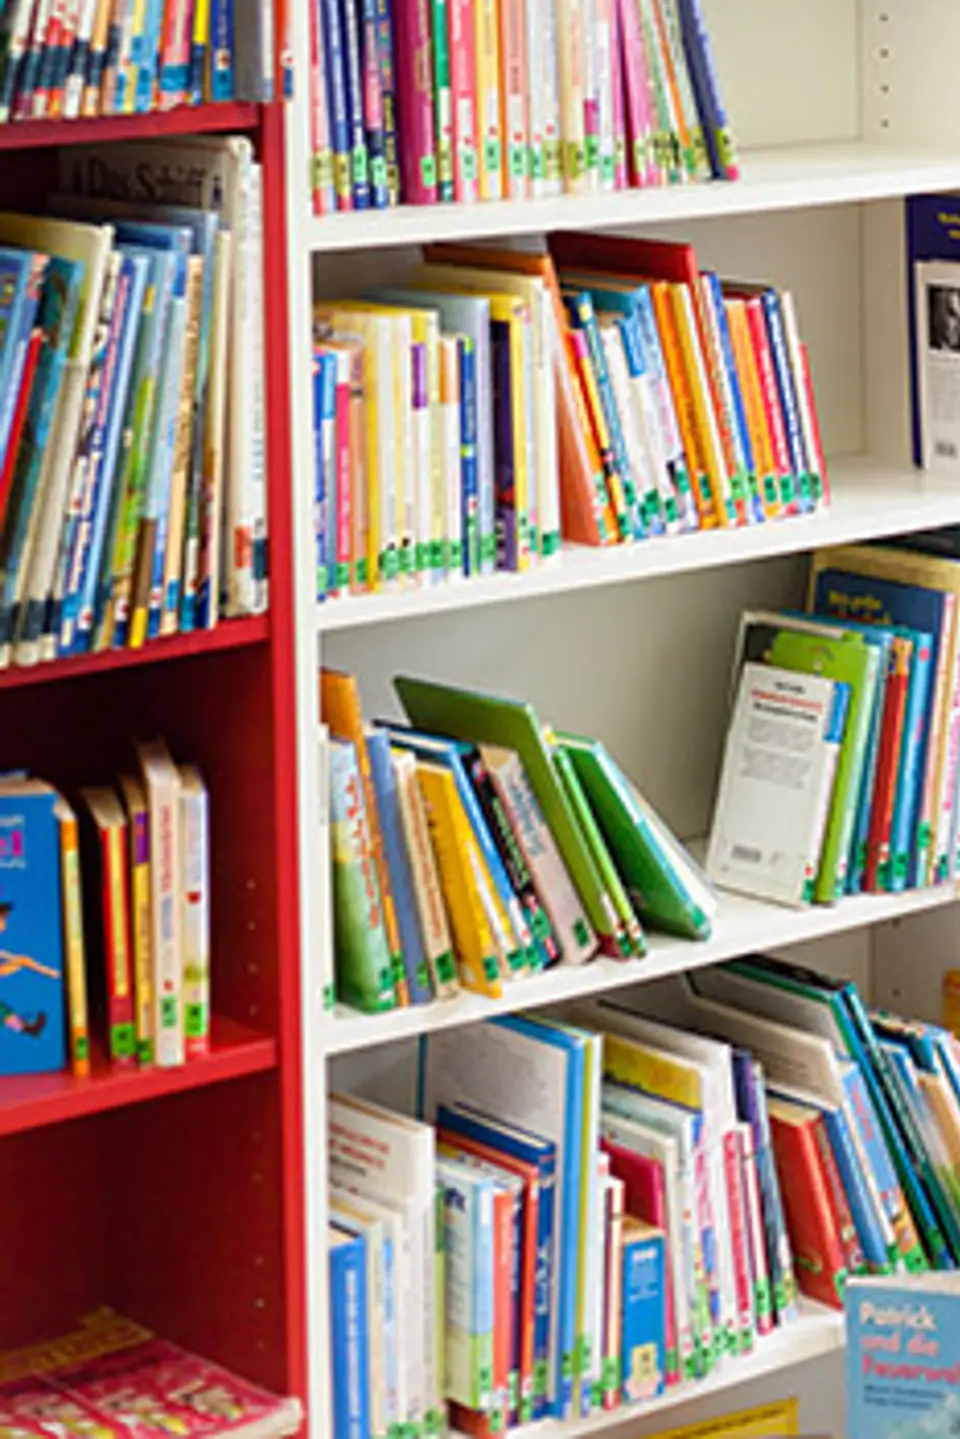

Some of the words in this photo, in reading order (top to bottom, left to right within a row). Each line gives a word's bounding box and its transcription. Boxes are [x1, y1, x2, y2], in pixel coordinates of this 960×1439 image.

[859, 1300, 939, 1330] Patrick
[859, 1329, 900, 1355] und
[906, 1331, 939, 1358] die
